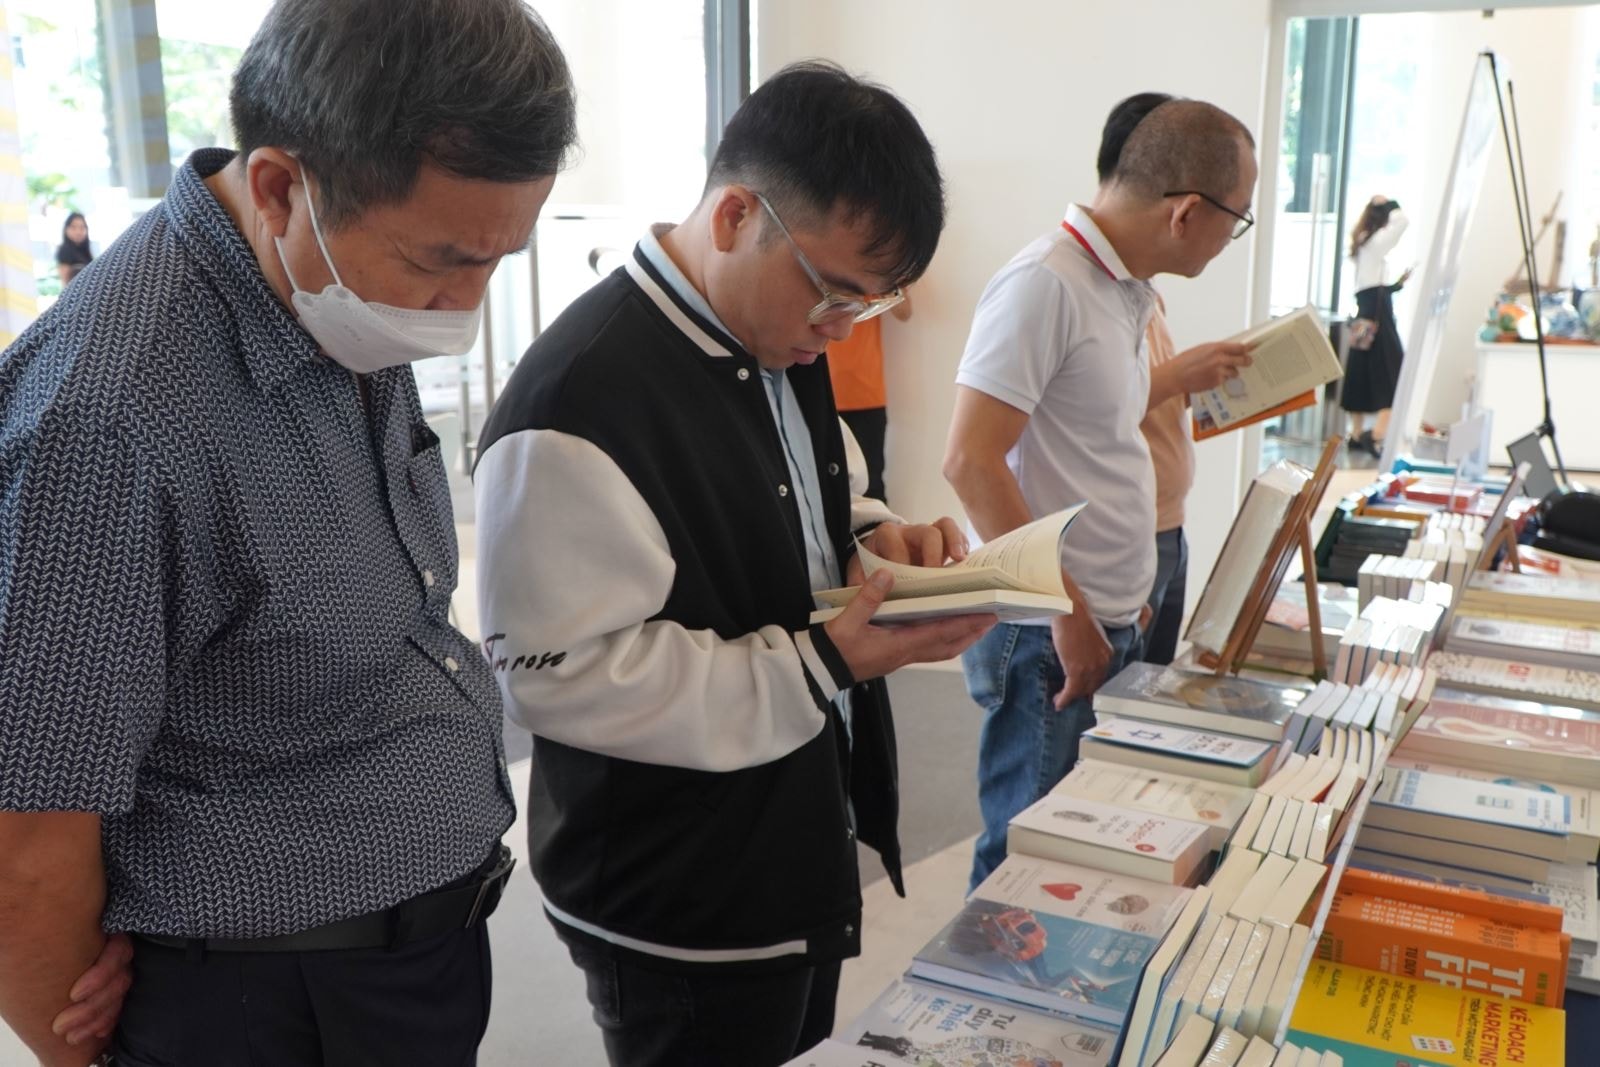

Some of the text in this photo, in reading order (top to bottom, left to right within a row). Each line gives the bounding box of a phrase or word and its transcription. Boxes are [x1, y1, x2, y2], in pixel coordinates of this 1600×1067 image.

[964, 1007, 994, 1031] duy
[1478, 1000, 1502, 1067] MARKETING
[1503, 1024, 1527, 1063] HOẠCH
